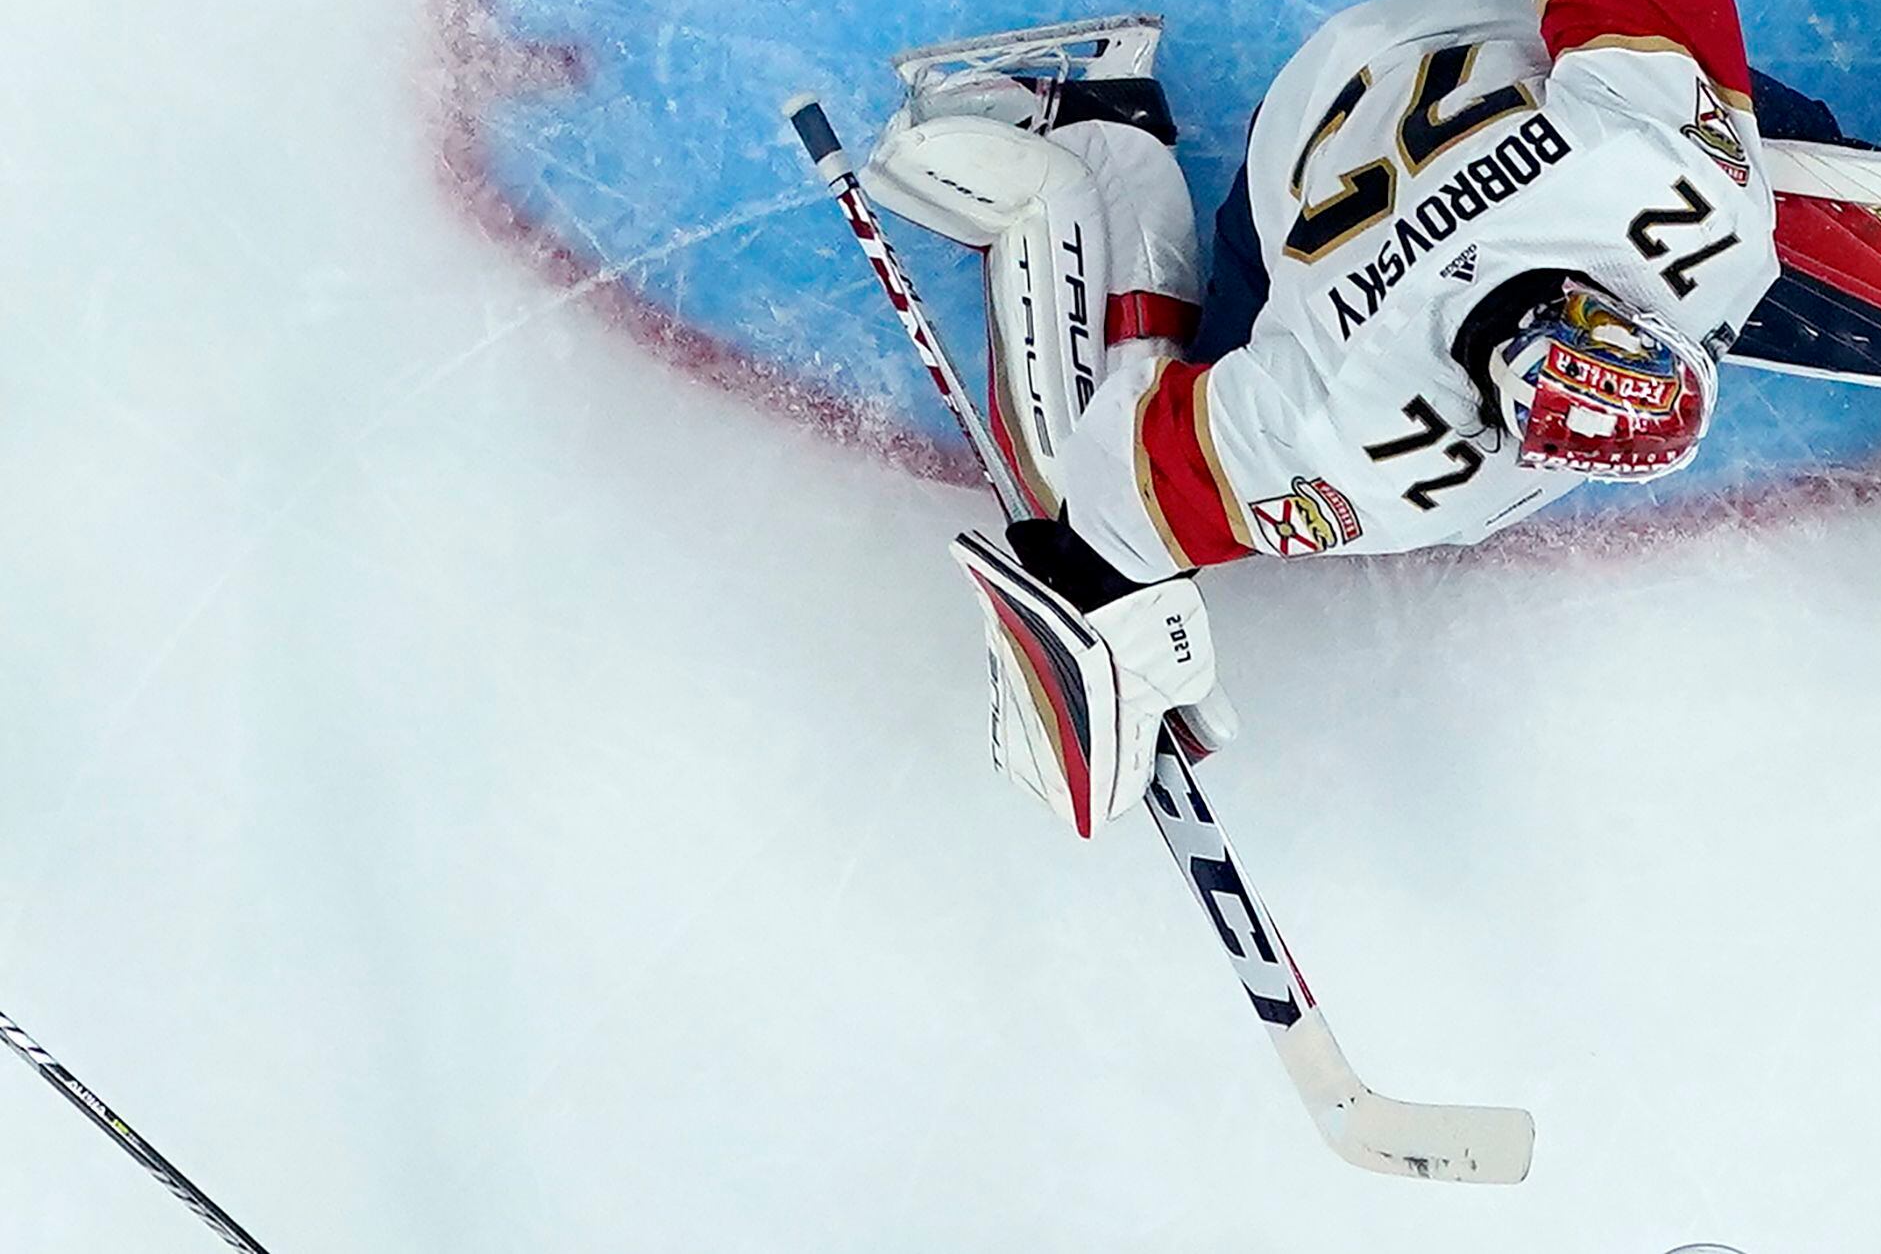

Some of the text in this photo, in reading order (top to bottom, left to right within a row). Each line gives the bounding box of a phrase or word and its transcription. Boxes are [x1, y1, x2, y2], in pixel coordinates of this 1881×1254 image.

[1061, 221, 1096, 416] TRUE
[1327, 113, 1573, 341] BOBROVSKY
[1627, 176, 1742, 300] 72
[1016, 235, 1055, 458] TRUE
[1362, 394, 1486, 512] 72
[1165, 614, 1193, 664] L20.2
[1147, 742, 1302, 1032] CC
